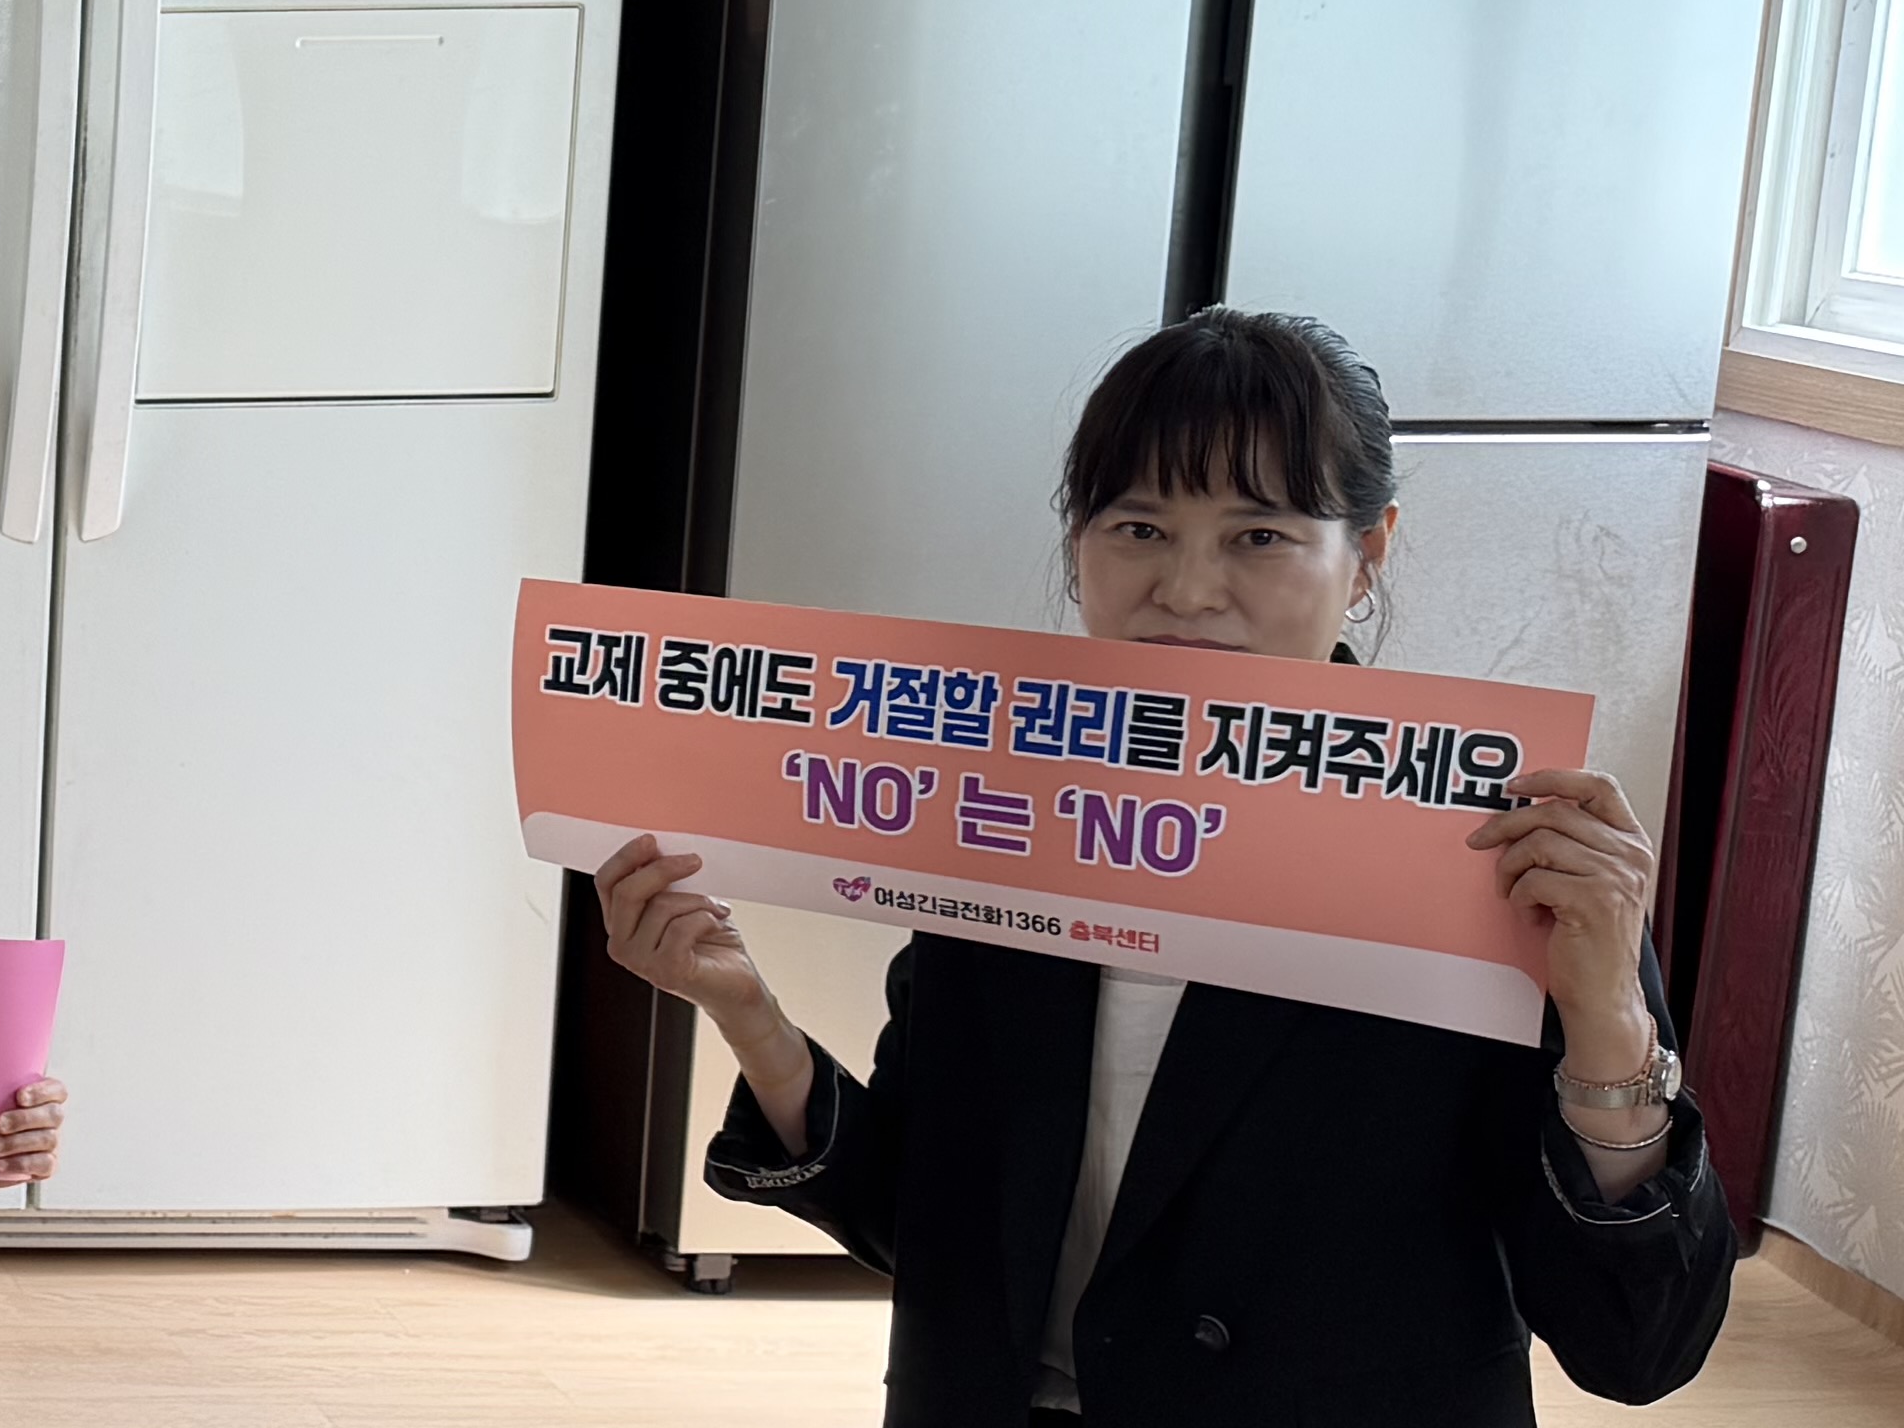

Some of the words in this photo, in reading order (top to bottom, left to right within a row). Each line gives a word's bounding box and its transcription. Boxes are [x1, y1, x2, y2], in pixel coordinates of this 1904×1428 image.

[540, 625, 646, 706] 교제
[656, 631, 817, 725] 중에도
[825, 658, 999, 750] 거절할
[1010, 677, 1188, 772] 권리를
[956, 774, 1034, 855] 는
[873, 881, 1063, 938] 여성긴급전화1366
[1068, 916, 1161, 955] 충북센터
